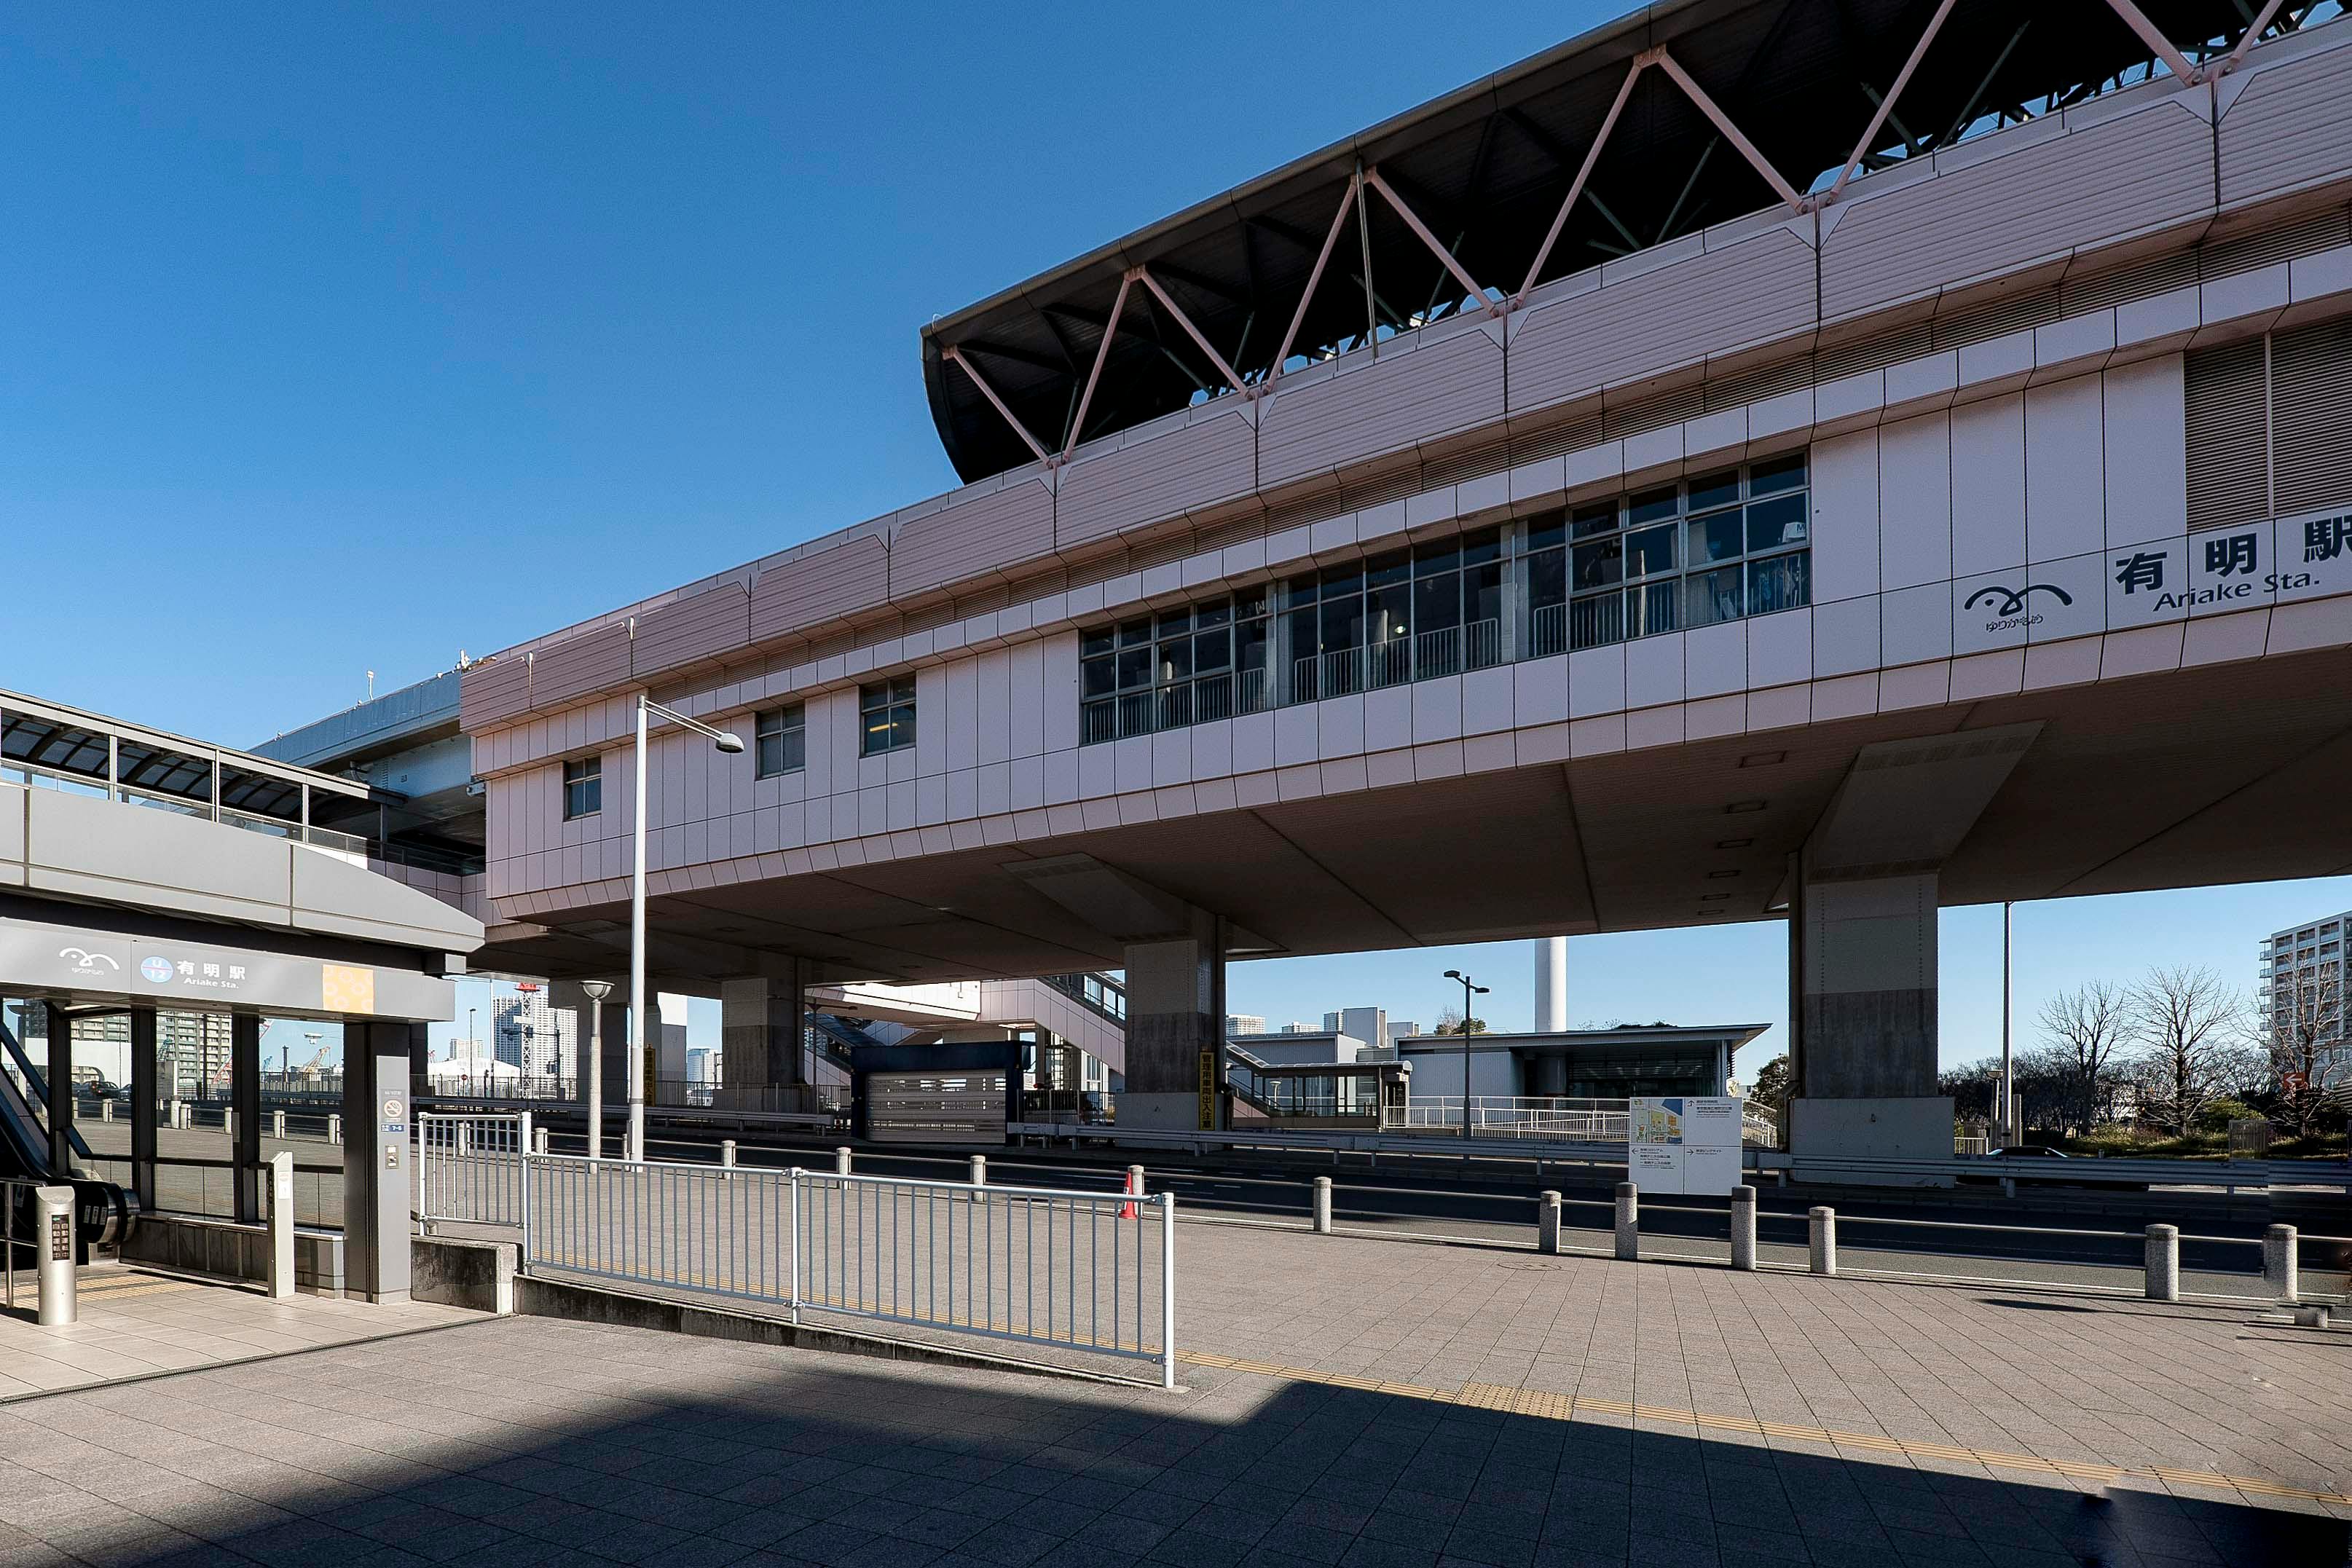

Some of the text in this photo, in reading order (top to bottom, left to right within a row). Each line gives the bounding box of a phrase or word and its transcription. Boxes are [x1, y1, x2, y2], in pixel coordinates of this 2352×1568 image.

[2152, 572, 2320, 612] Ariake Sta.
[1986, 614, 2044, 633] ゆりかもめ
[152, 959, 161, 967] U
[177, 961, 245, 980] 有明駅
[150, 969, 167, 979] 12
[184, 977, 239, 989] Ariake Sta.
